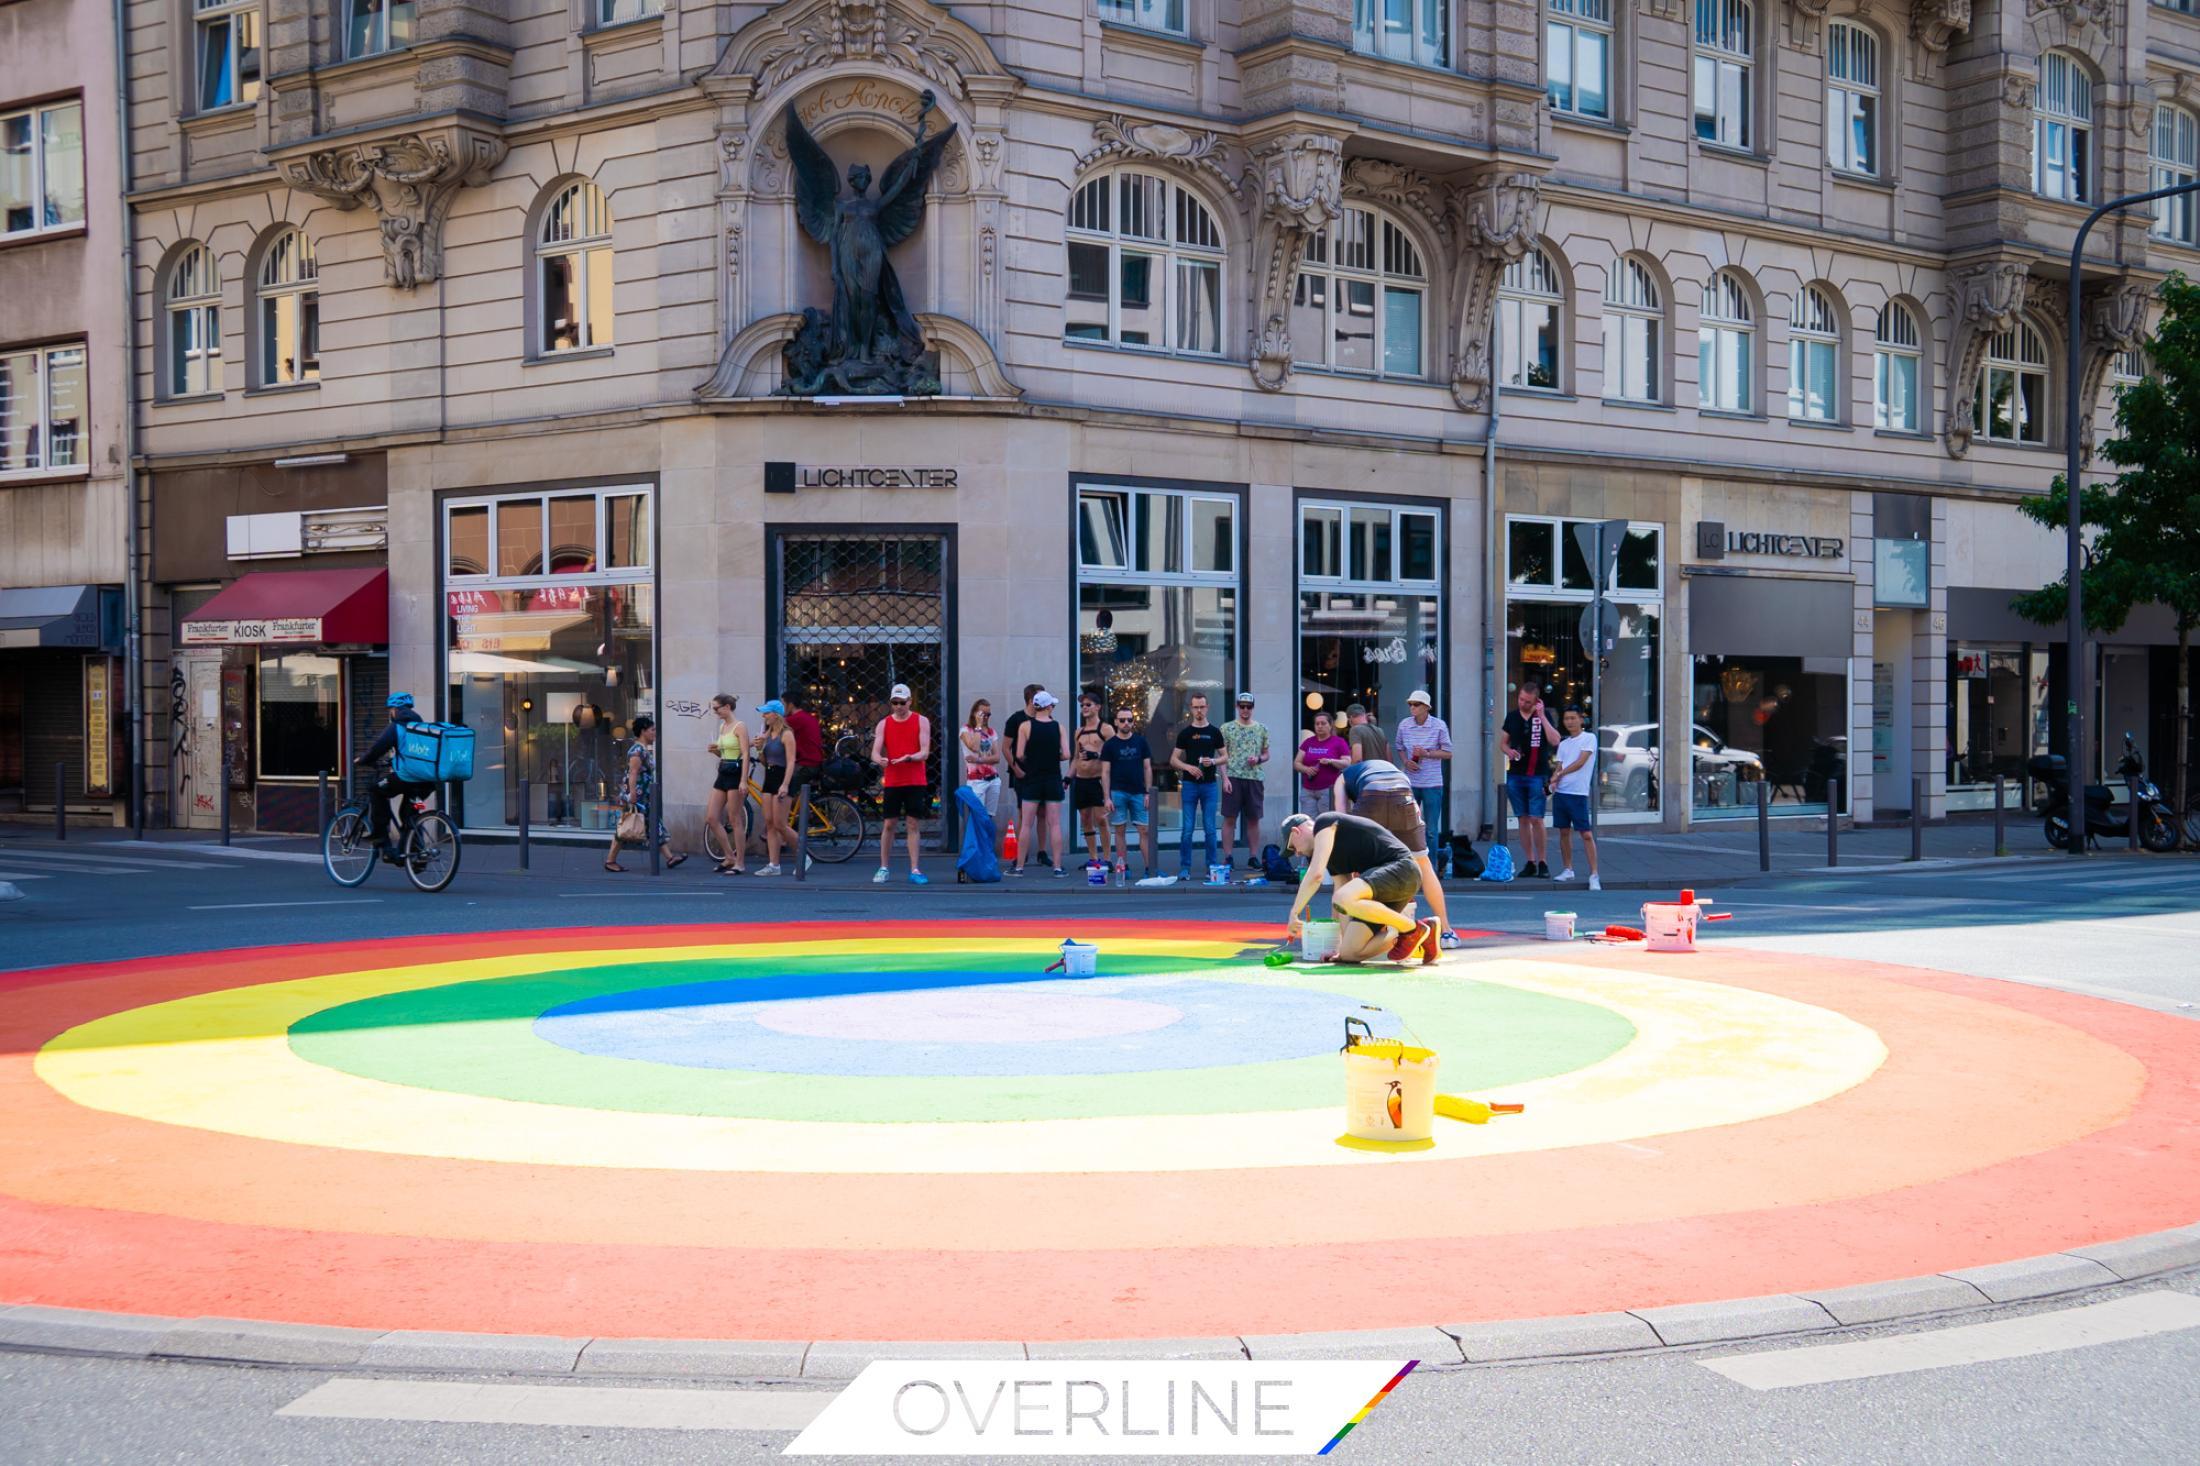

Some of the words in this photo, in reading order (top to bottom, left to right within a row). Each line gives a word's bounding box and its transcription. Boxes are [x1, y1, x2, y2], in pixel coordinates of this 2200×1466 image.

[803, 469, 958, 487] LICHTCENTER
[1728, 531, 1844, 558] LICHTCENTER
[187, 624, 229, 633] Frankfurter
[234, 625, 266, 638] KIOSK
[273, 621, 316, 631] Frankfurter
